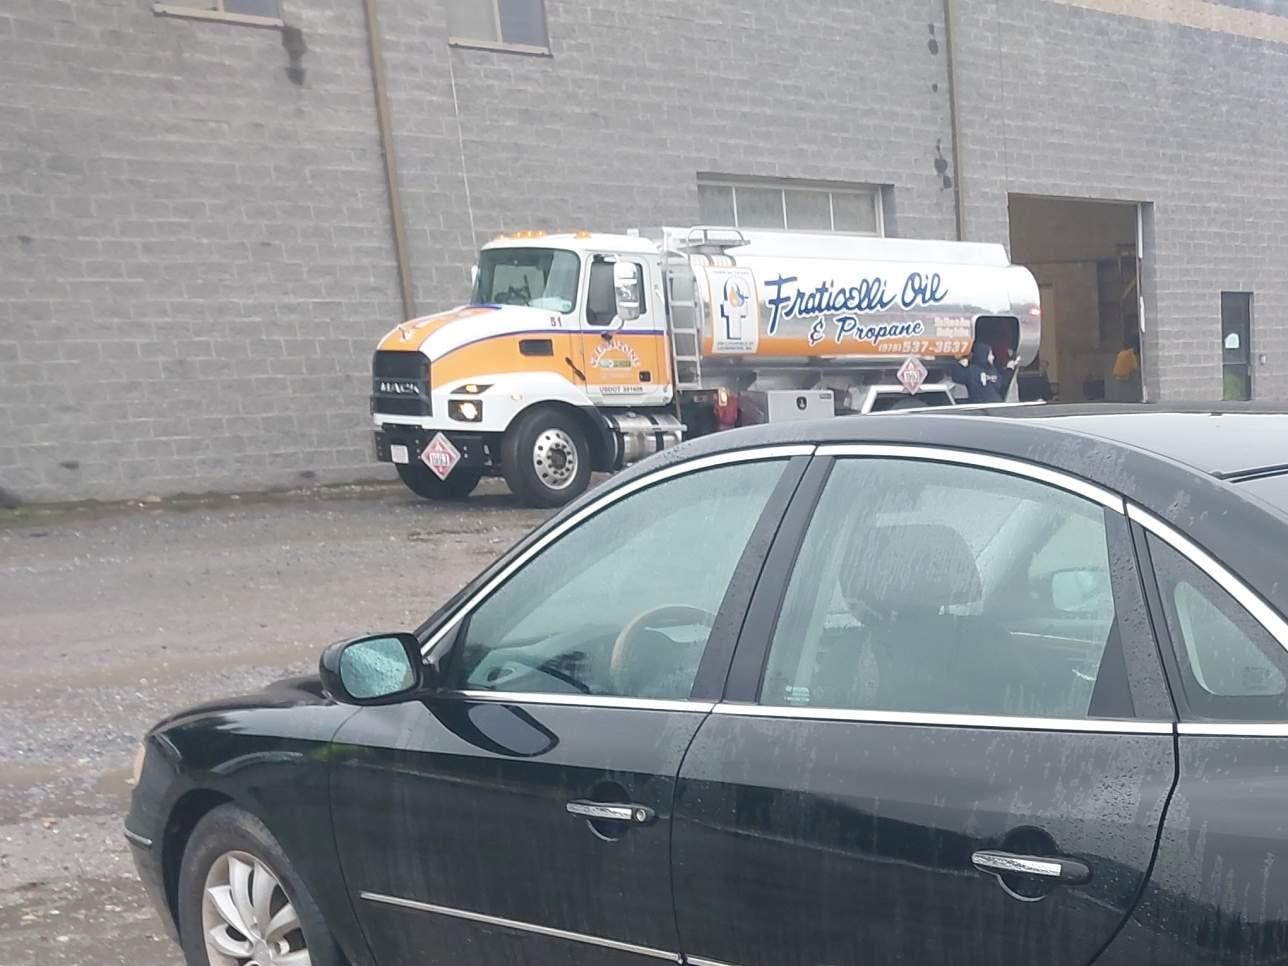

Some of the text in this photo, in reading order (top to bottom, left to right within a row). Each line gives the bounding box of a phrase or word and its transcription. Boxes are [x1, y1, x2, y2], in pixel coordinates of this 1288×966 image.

[764, 270, 951, 334] Fraticelli Oil
[808, 316, 925, 346] & Propane
[380, 382, 420, 394] MACK
